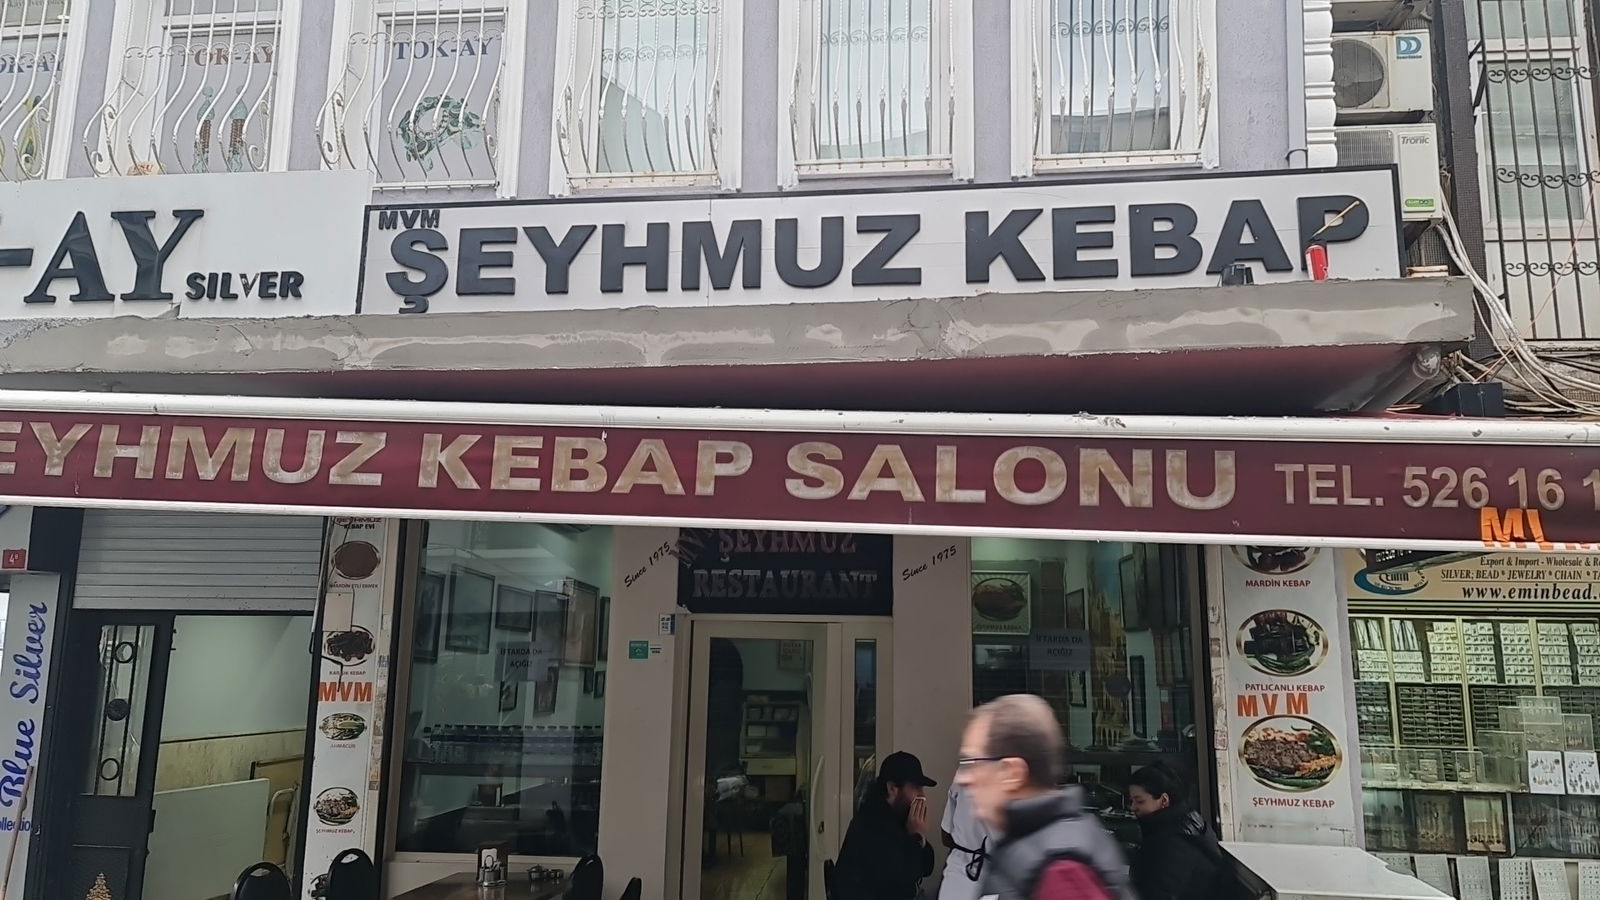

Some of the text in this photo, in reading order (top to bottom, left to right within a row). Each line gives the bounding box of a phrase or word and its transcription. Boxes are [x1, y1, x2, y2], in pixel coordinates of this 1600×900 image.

[393, 37, 492, 60] TOK-AY
[1401, 136, 1430, 145] Tronic
[378, 210, 440, 230] MVM
[385, 194, 1369, 314] ŞEYHMUZ KEBAP
[185, 271, 304, 300] SILVER
[417, 433, 753, 497] KEBAP
[785, 441, 1236, 510] SALONU
[1275, 463, 1384, 507] TEL.
[1403, 465, 1490, 509] 526
[1508, 467, 1565, 511] 16
[624, 541, 671, 588] Since 1975
[902, 545, 957, 581] Since 1975
[1480, 557, 1505, 568] Export
[1506, 557, 1513, 566] &
[1515, 557, 1540, 568] Import
[1546, 557, 1582, 567] Wholesale
[1584, 557, 1591, 567] &
[692, 569, 879, 599] RESTAURANT
[1245, 578, 1311, 588] MARDİN KEBAP
[1476, 569, 1500, 579] BEAD
[1507, 570, 1547, 580] JEWELRY
[1554, 570, 1583, 580] CHAIN
[1462, 583, 1600, 600] www.eminbead.
[318, 681, 372, 702] MVM
[1245, 683, 1326, 693] PATLICANLI KEBAP
[0, 602, 48, 807] Blue Silver
[1252, 797, 1335, 809] ŞEYHMUZ KEBAP
